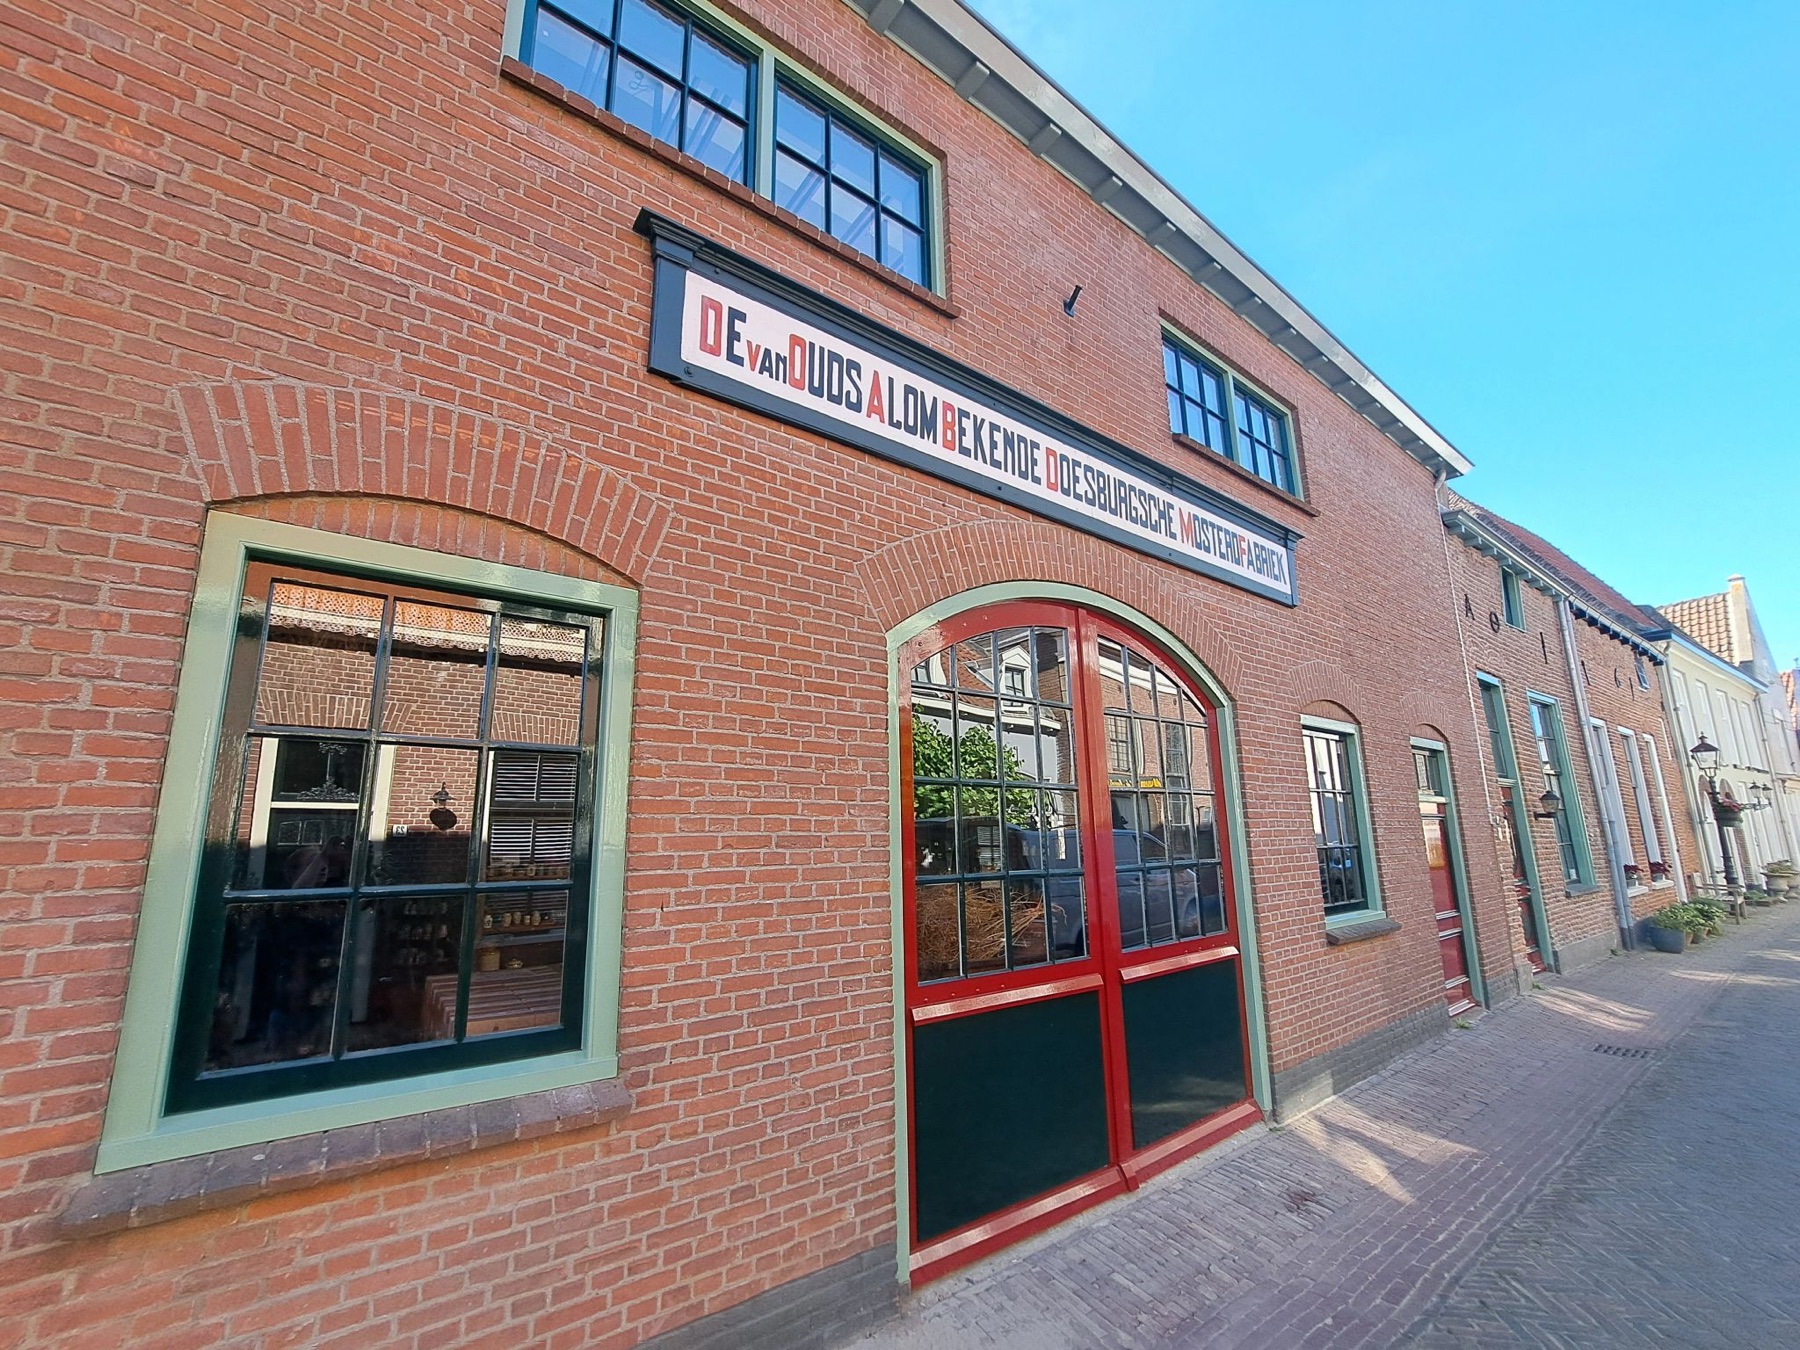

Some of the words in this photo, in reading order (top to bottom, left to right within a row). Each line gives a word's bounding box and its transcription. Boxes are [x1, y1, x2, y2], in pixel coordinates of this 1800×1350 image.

[699, 294, 747, 367] DE
[788, 333, 862, 414] OUDS
[942, 400, 1042, 486] BEKENDE
[1045, 446, 1178, 541] DOESBURGSCHE
